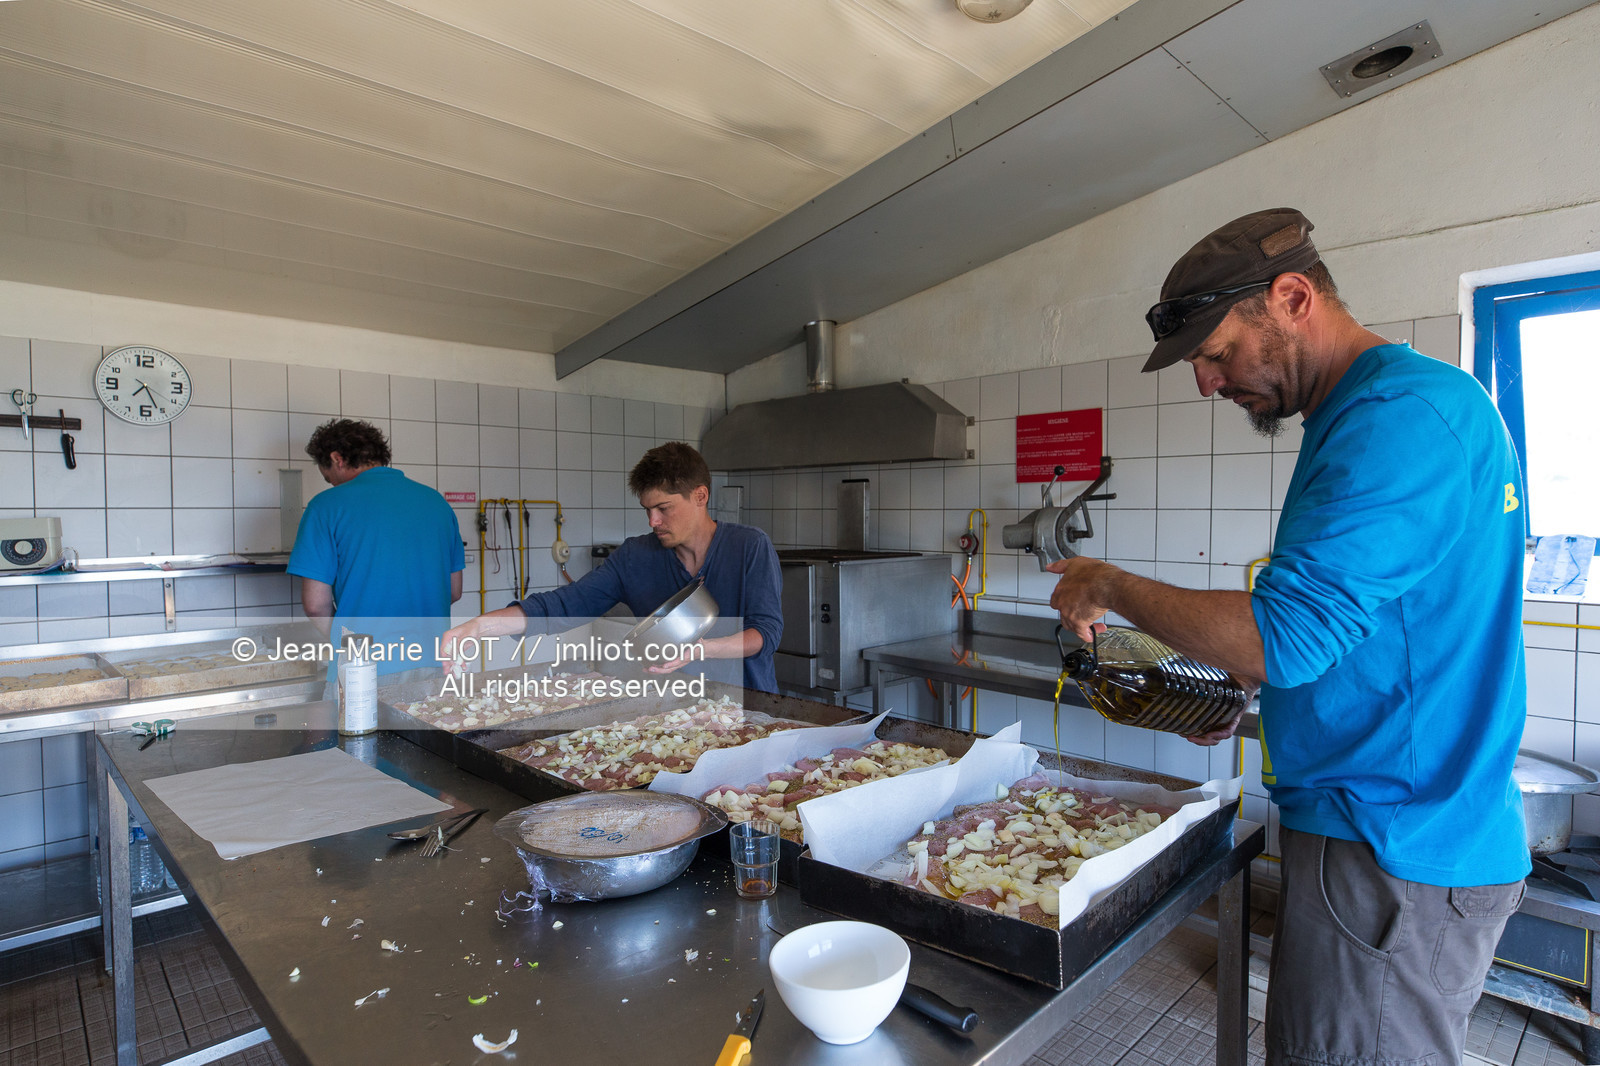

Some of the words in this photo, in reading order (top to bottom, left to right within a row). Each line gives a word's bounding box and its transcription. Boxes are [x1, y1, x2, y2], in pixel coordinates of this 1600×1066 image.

[134, 354, 155, 368] 12
[105, 377, 119, 390] 9
[170, 382, 183, 394] 3
[139, 405, 152, 417] 6
[1504, 482, 1519, 514] B
